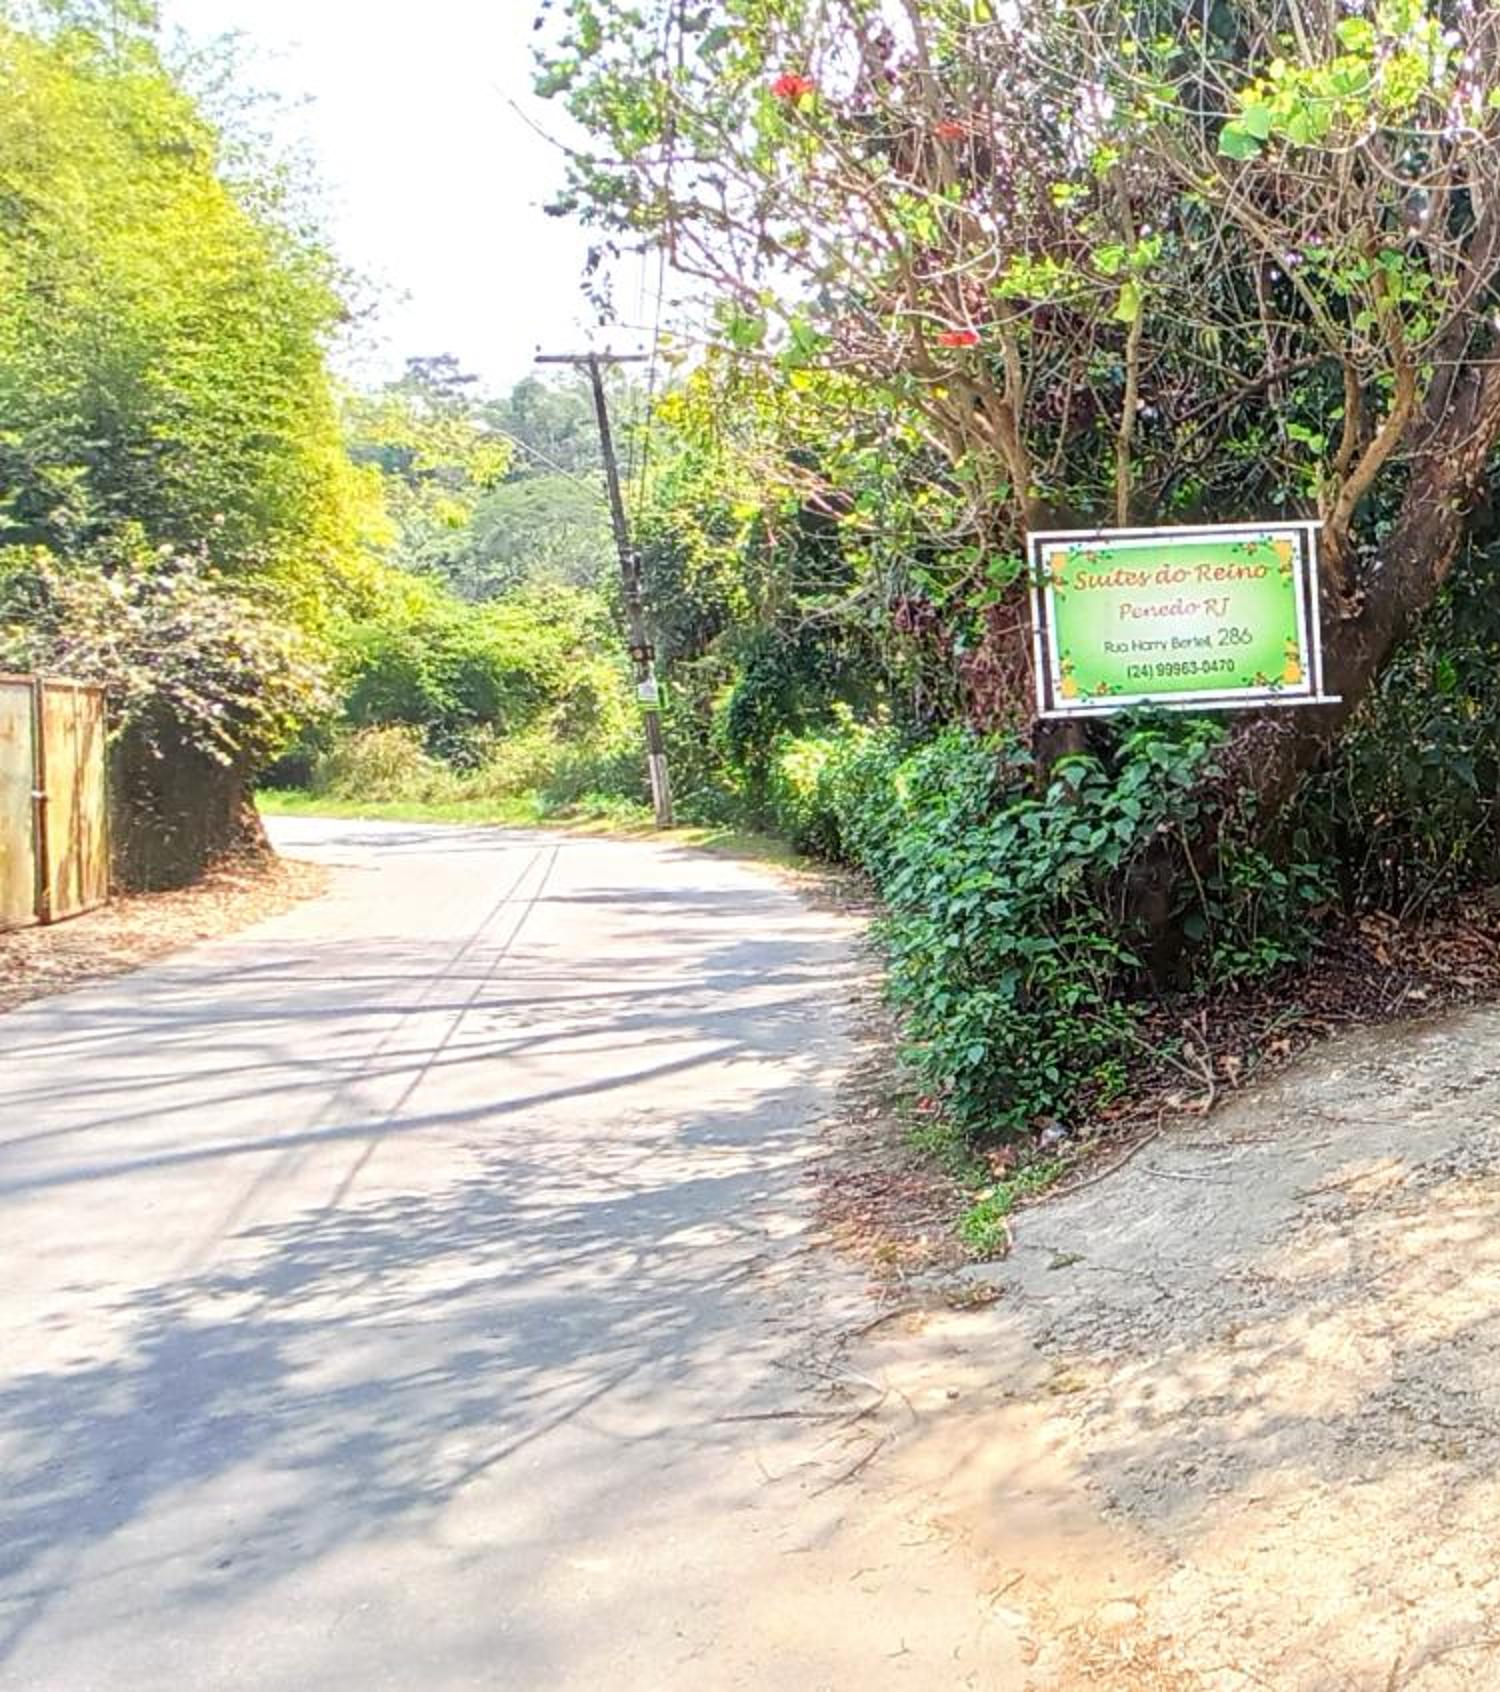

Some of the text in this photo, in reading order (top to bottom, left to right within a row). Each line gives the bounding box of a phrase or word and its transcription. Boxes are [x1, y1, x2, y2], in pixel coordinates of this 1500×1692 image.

[1155, 564, 1192, 585] do
[1195, 563, 1272, 582] Reino
[1119, 597, 1230, 620] Penedo RJ
[1104, 640, 1128, 653] Rua
[1132, 638, 1168, 652] Harry
[1218, 627, 1253, 646] 286
[1127, 659, 1235, 679] (24) 99963-0470
